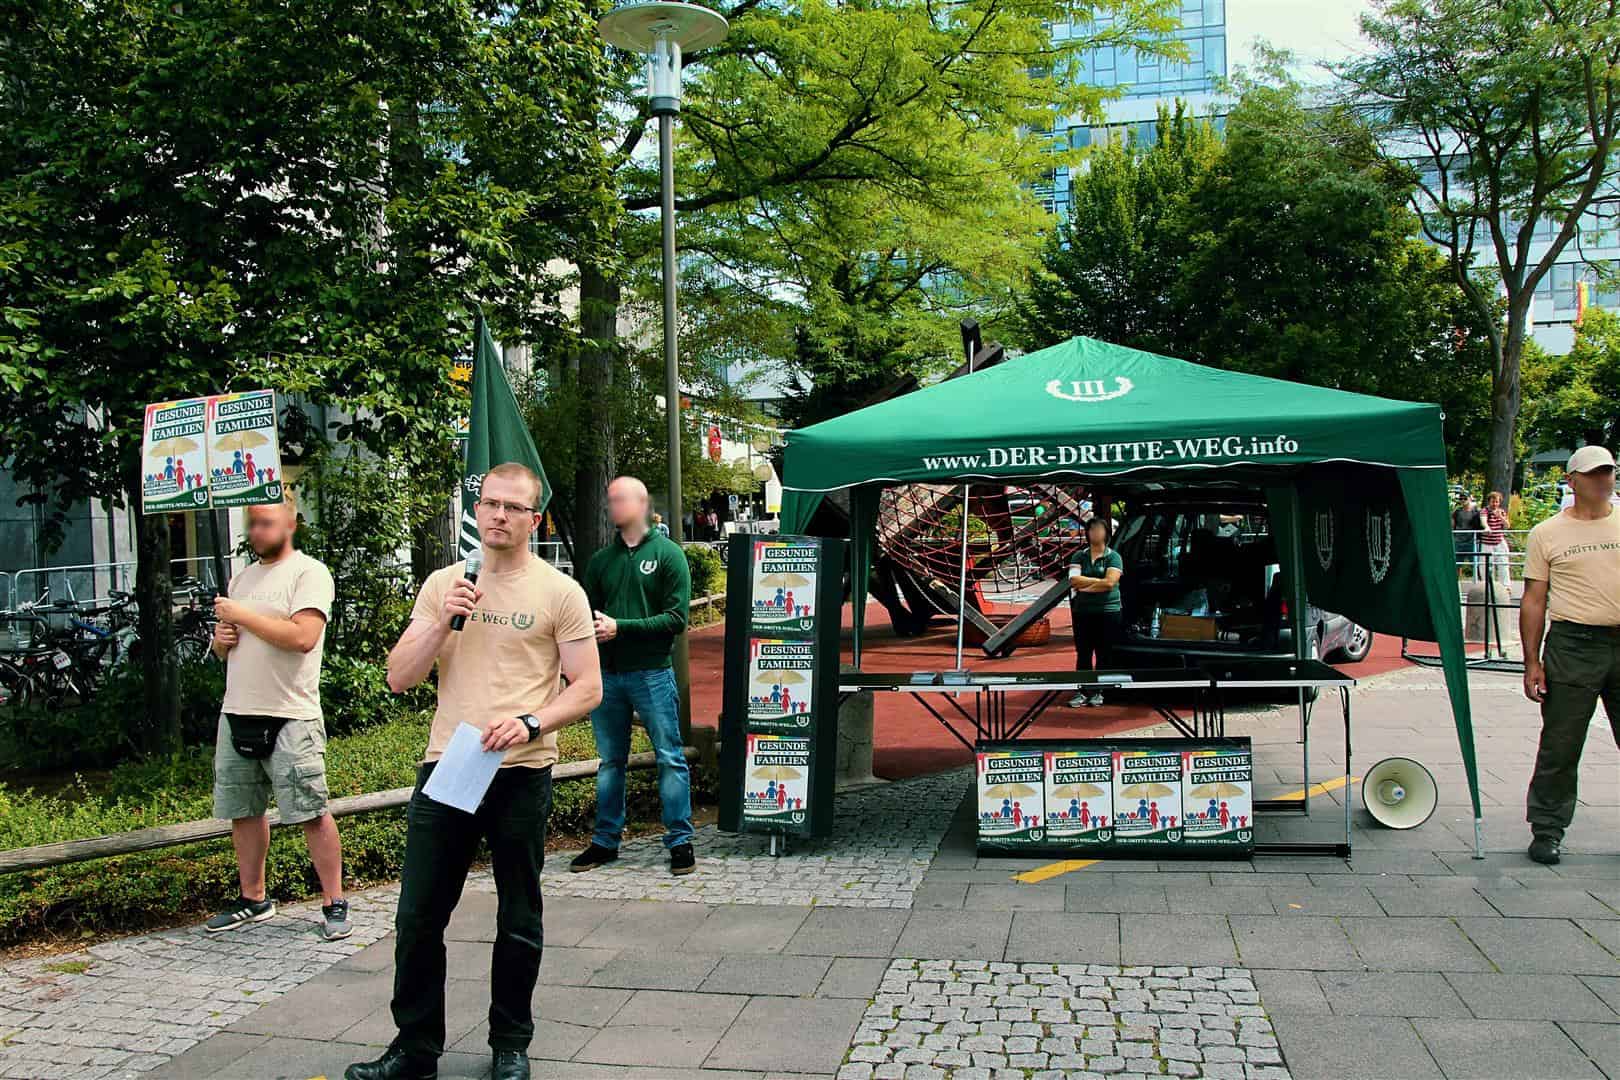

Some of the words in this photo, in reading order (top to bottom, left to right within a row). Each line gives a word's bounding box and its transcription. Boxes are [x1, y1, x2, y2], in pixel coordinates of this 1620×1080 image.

[220, 397, 270, 414] GESUNDE
[158, 405, 203, 421] GESUNDE
[217, 415, 272, 432] FAMILIEN
[154, 422, 203, 440] FAMILIEN
[923, 434, 1299, 470] www.DER-DRITTE-WEG.info
[767, 549, 815, 558] GESUNDE
[764, 563, 816, 572] FAMILIEN
[482, 612, 508, 626] WEG
[763, 646, 810, 654] GESUNDE
[760, 660, 811, 669] FAMILIEN
[760, 742, 807, 750] GESUNDE
[756, 756, 807, 765] FAMILIEN
[990, 757, 1040, 768] GESUNDE
[1058, 757, 1108, 768] GESUNDE
[1126, 757, 1178, 768] GESUNDE
[1196, 757, 1248, 768] GESUNDE
[988, 772, 1041, 783] FAMILIEN
[1055, 772, 1109, 783] FAMILIEN
[1124, 772, 1179, 783] FAMILIEN
[1193, 772, 1249, 783] FAMILIEN
